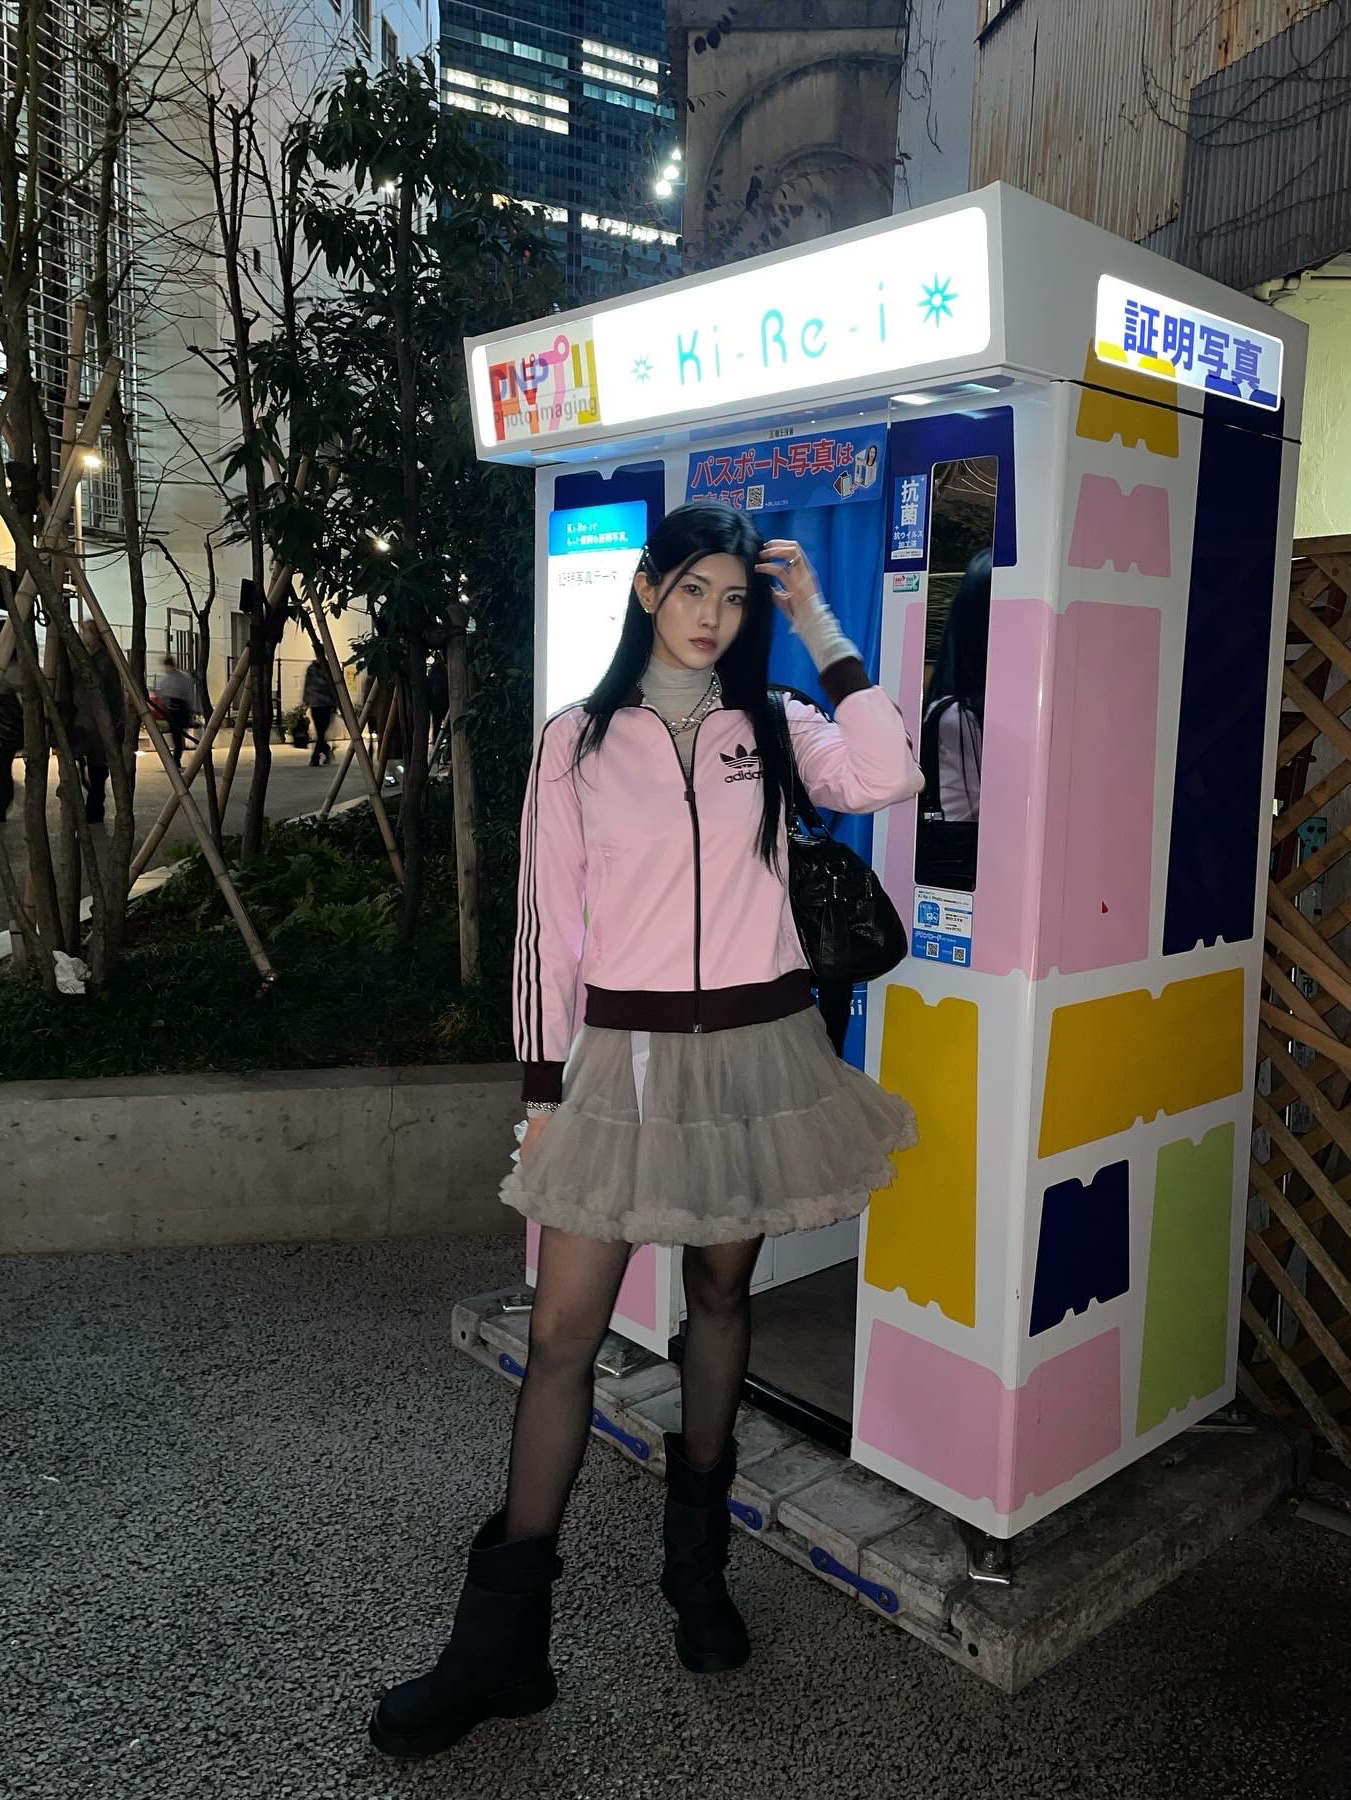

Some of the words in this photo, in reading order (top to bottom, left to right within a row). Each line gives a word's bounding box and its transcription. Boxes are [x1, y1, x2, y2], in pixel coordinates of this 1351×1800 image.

[1123, 299, 1263, 391] 証明写真
[691, 438, 854, 488] パスポート写真は
[901, 480, 920, 526] 抗菌
[893, 530, 924, 540] 抗ウイルス
[724, 770, 764, 784] adida
